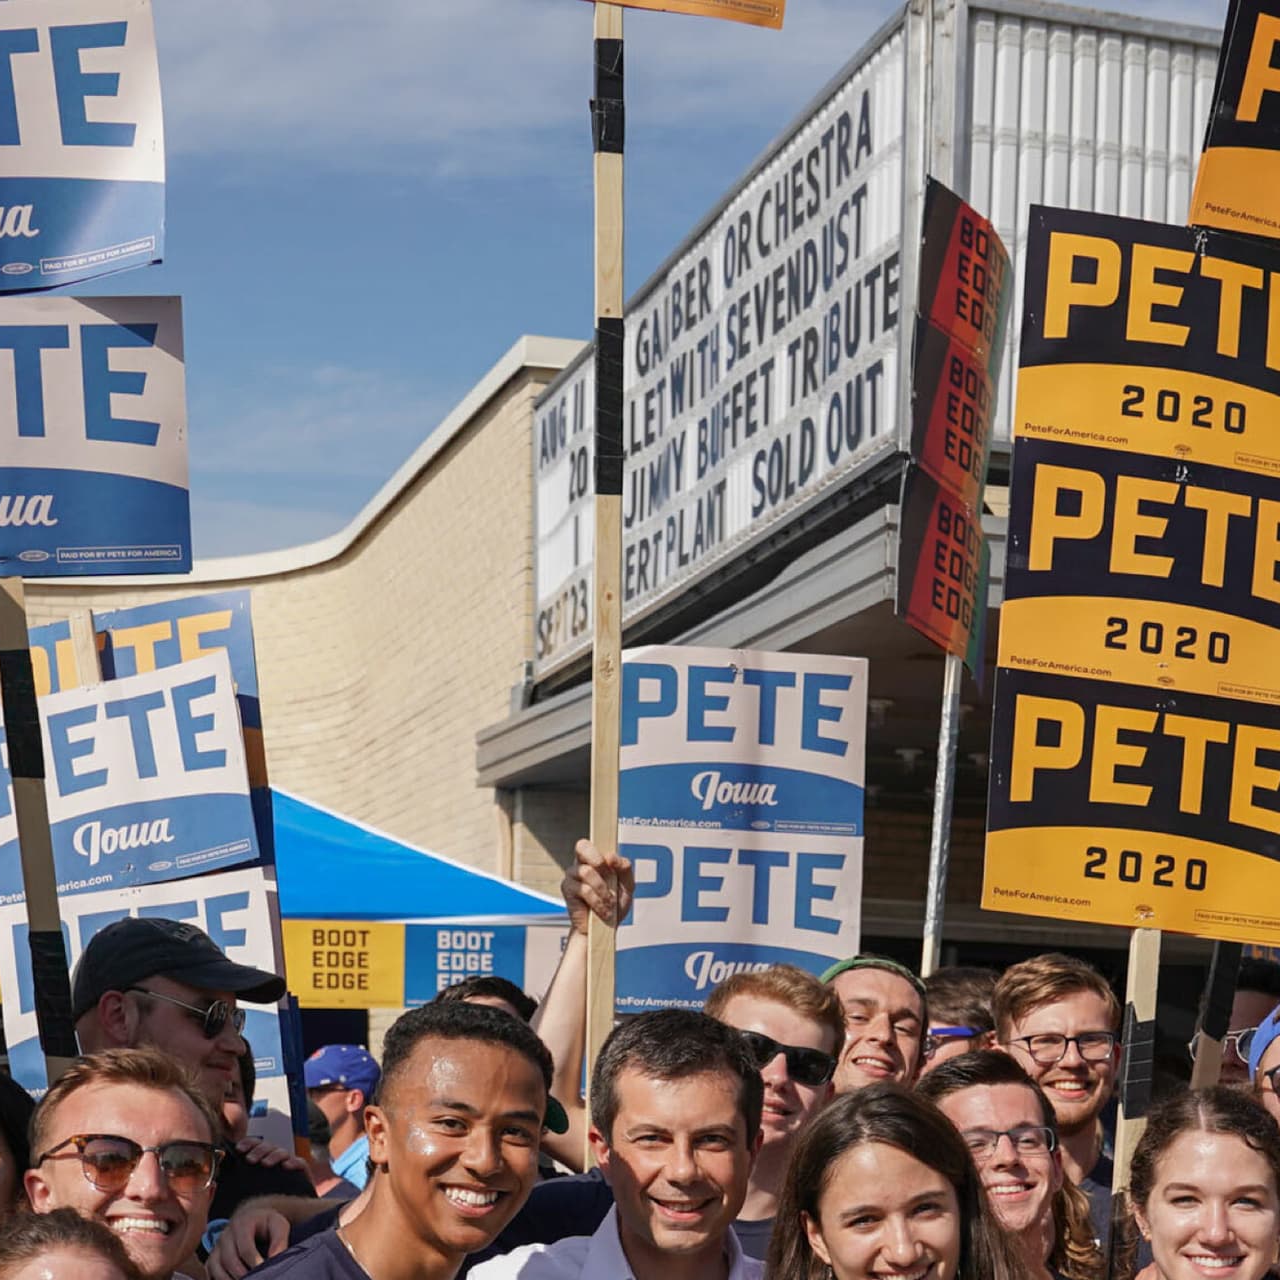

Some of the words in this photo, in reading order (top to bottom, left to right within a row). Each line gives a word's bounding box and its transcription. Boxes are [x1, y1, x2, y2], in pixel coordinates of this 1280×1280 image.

[723, 88, 873, 289] ORCHESTRA
[44, 259, 60, 271] PAID
[62, 257, 77, 268] FOR
[89, 252, 105, 264] PETE
[106, 248, 120, 260] FOR
[121, 241, 152, 257] AMERICA
[569, 445, 588, 505] 20
[725, 182, 868, 373] SEVENDUST
[697, 356, 775, 482] BUFFET
[787, 250, 900, 407] TRIBUTE
[1121, 384, 1247, 435] 2020
[1024, 422, 1129, 446] PeteForAmerica.com
[571, 578, 589, 638] 23
[625, 530, 662, 601] ERT
[751, 417, 817, 518] SOLD
[826, 359, 884, 467] OUT
[60, 551, 76, 560] PAID
[78, 551, 93, 560] FOR
[107, 550, 125, 560] PETE
[127, 549, 141, 559] FOR
[143, 548, 179, 559] AMERICA
[1104, 617, 1231, 665] 2020
[1010, 654, 1112, 677] PeteForAmerica.com
[621, 662, 853, 758] PETE
[690, 771, 778, 811] Iowa
[73, 817, 175, 866] Iowa
[1084, 846, 1208, 892] 2020
[619, 843, 847, 936] PETE
[992, 886, 1092, 907] PeteForAmerica.com
[312, 928, 370, 948] BOOT
[437, 930, 495, 950] BOOT
[313, 950, 369, 969] EDGE
[437, 952, 494, 972] EDGE
[313, 972, 369, 991] EDGE
